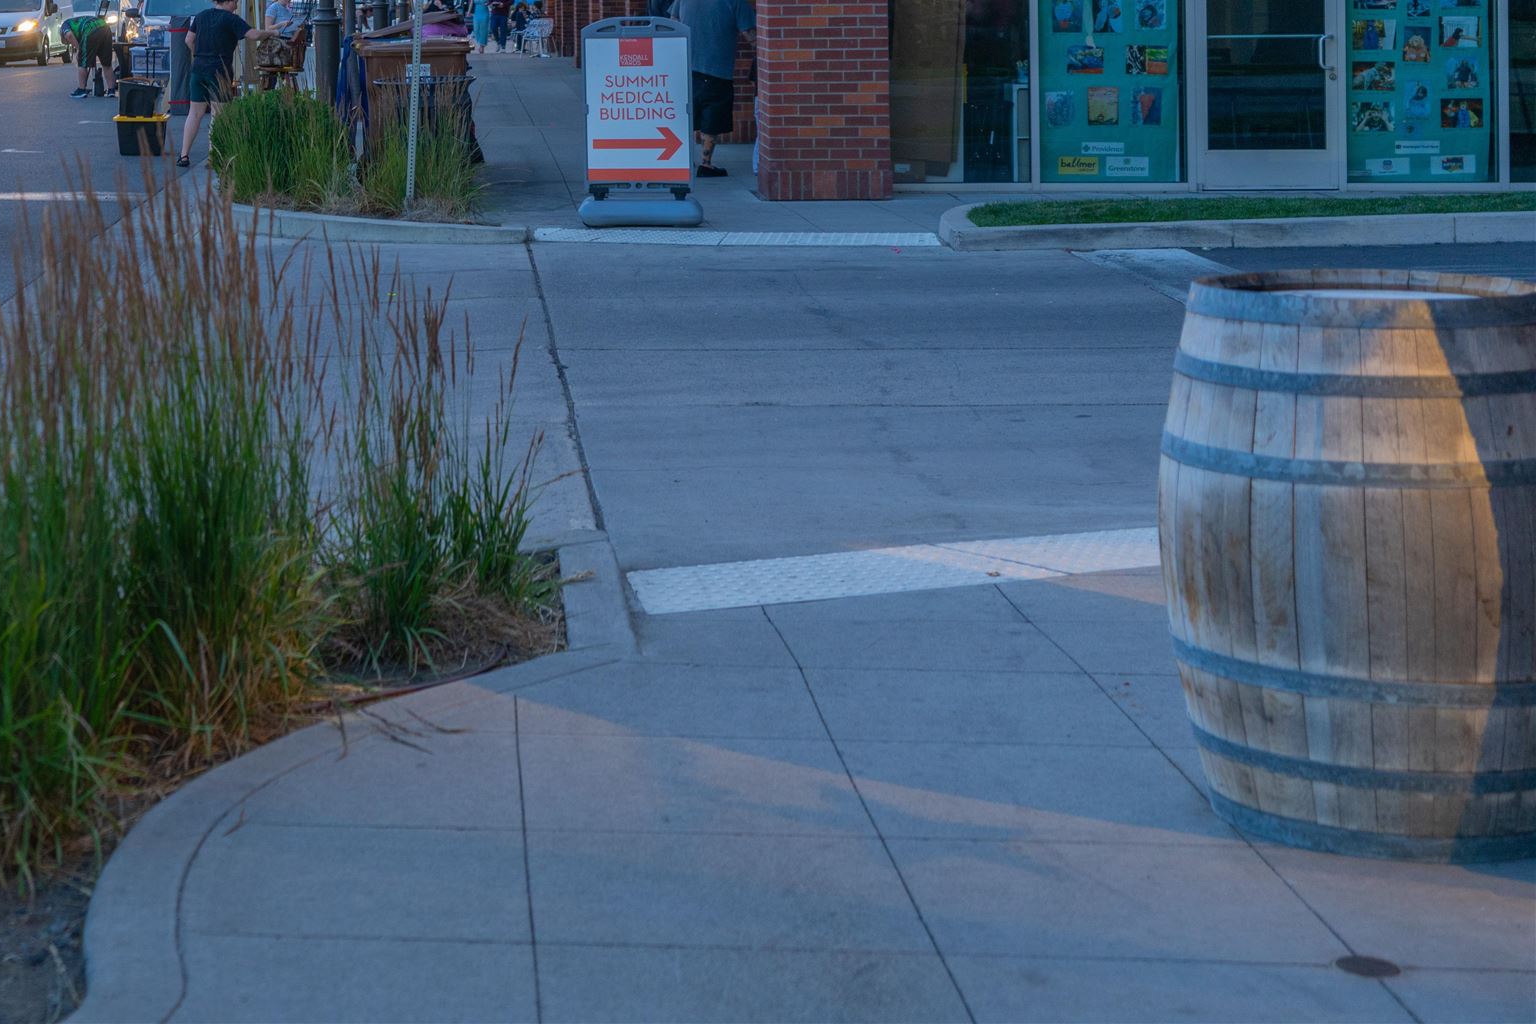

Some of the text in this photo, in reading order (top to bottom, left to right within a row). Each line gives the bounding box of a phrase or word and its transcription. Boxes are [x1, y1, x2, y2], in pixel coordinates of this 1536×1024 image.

[604, 74, 669, 88] SUMMIT
[601, 90, 674, 104] MEDICAL
[599, 107, 676, 121] BUILDING
[1060, 157, 1096, 169] ballmer
